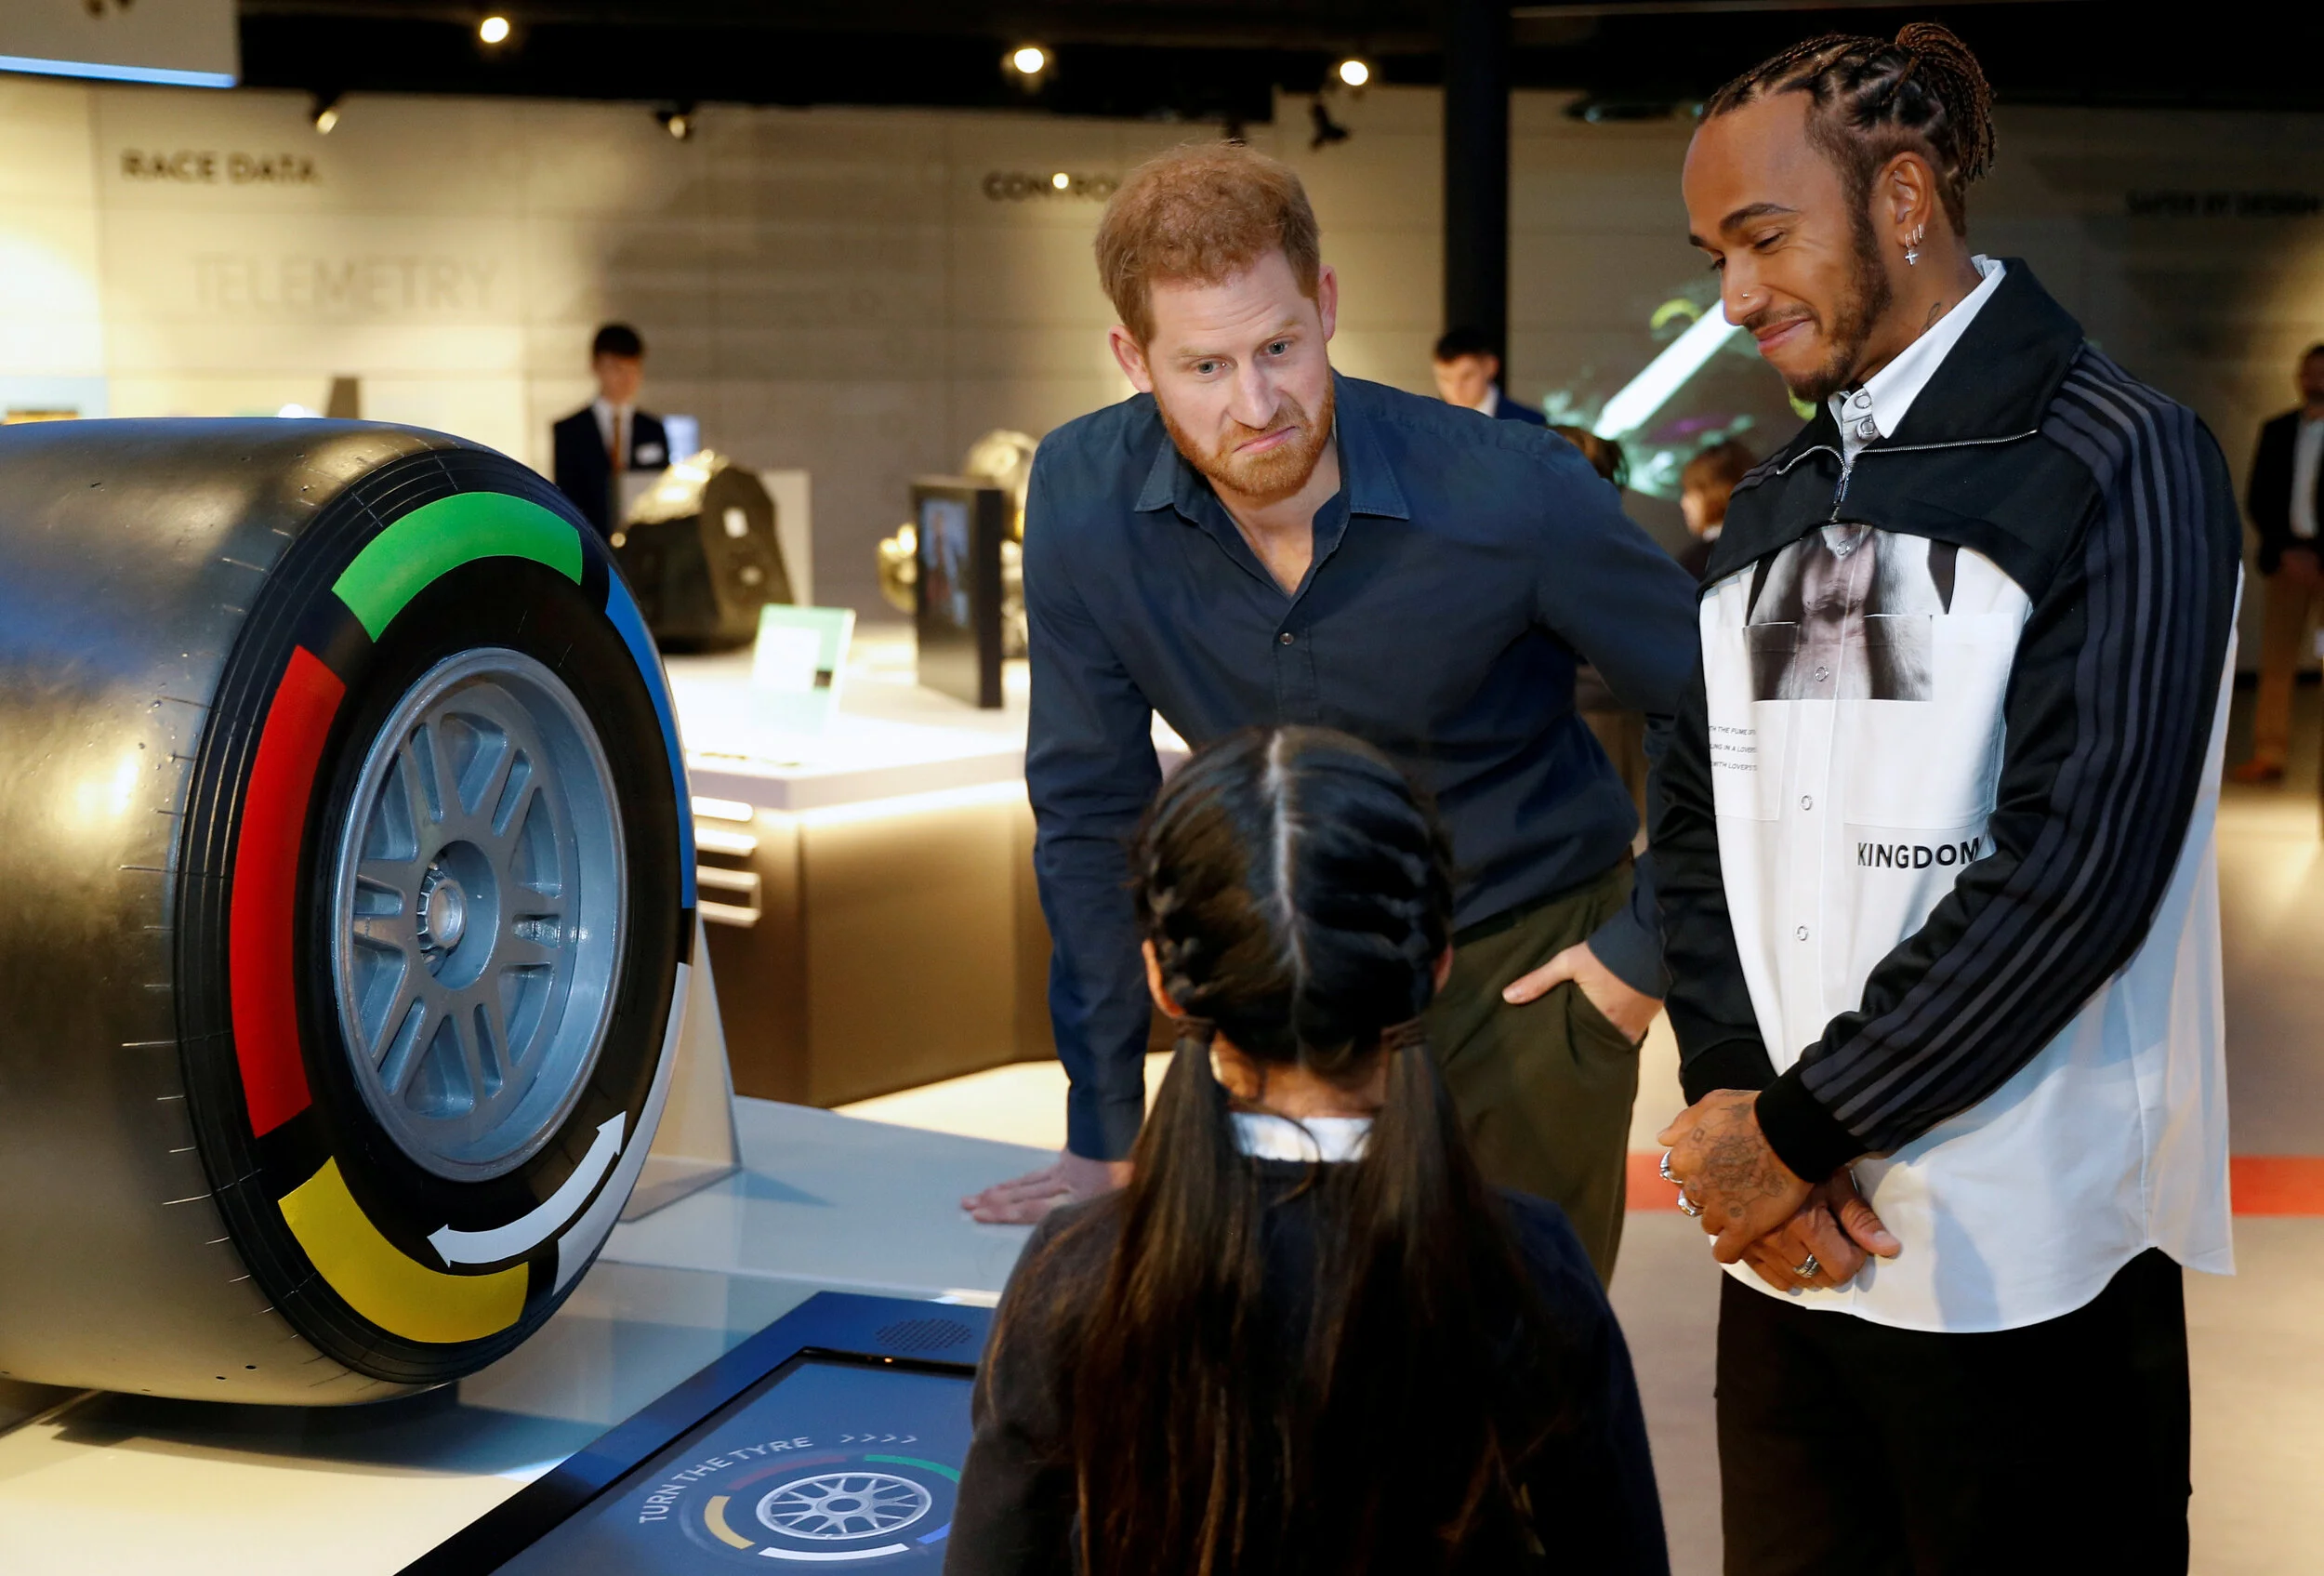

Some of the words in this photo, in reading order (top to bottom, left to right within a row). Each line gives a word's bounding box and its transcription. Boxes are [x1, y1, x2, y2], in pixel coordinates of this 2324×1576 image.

[120, 147, 218, 183] RACE
[226, 150, 322, 185] DATA
[983, 171, 1119, 202] CONRO
[191, 252, 501, 311] TELEMETRY
[1857, 837, 1979, 868] KINGDOM
[639, 1484, 687, 1524] TURN
[671, 1457, 734, 1481] THE
[728, 1437, 814, 1460] TYRE
